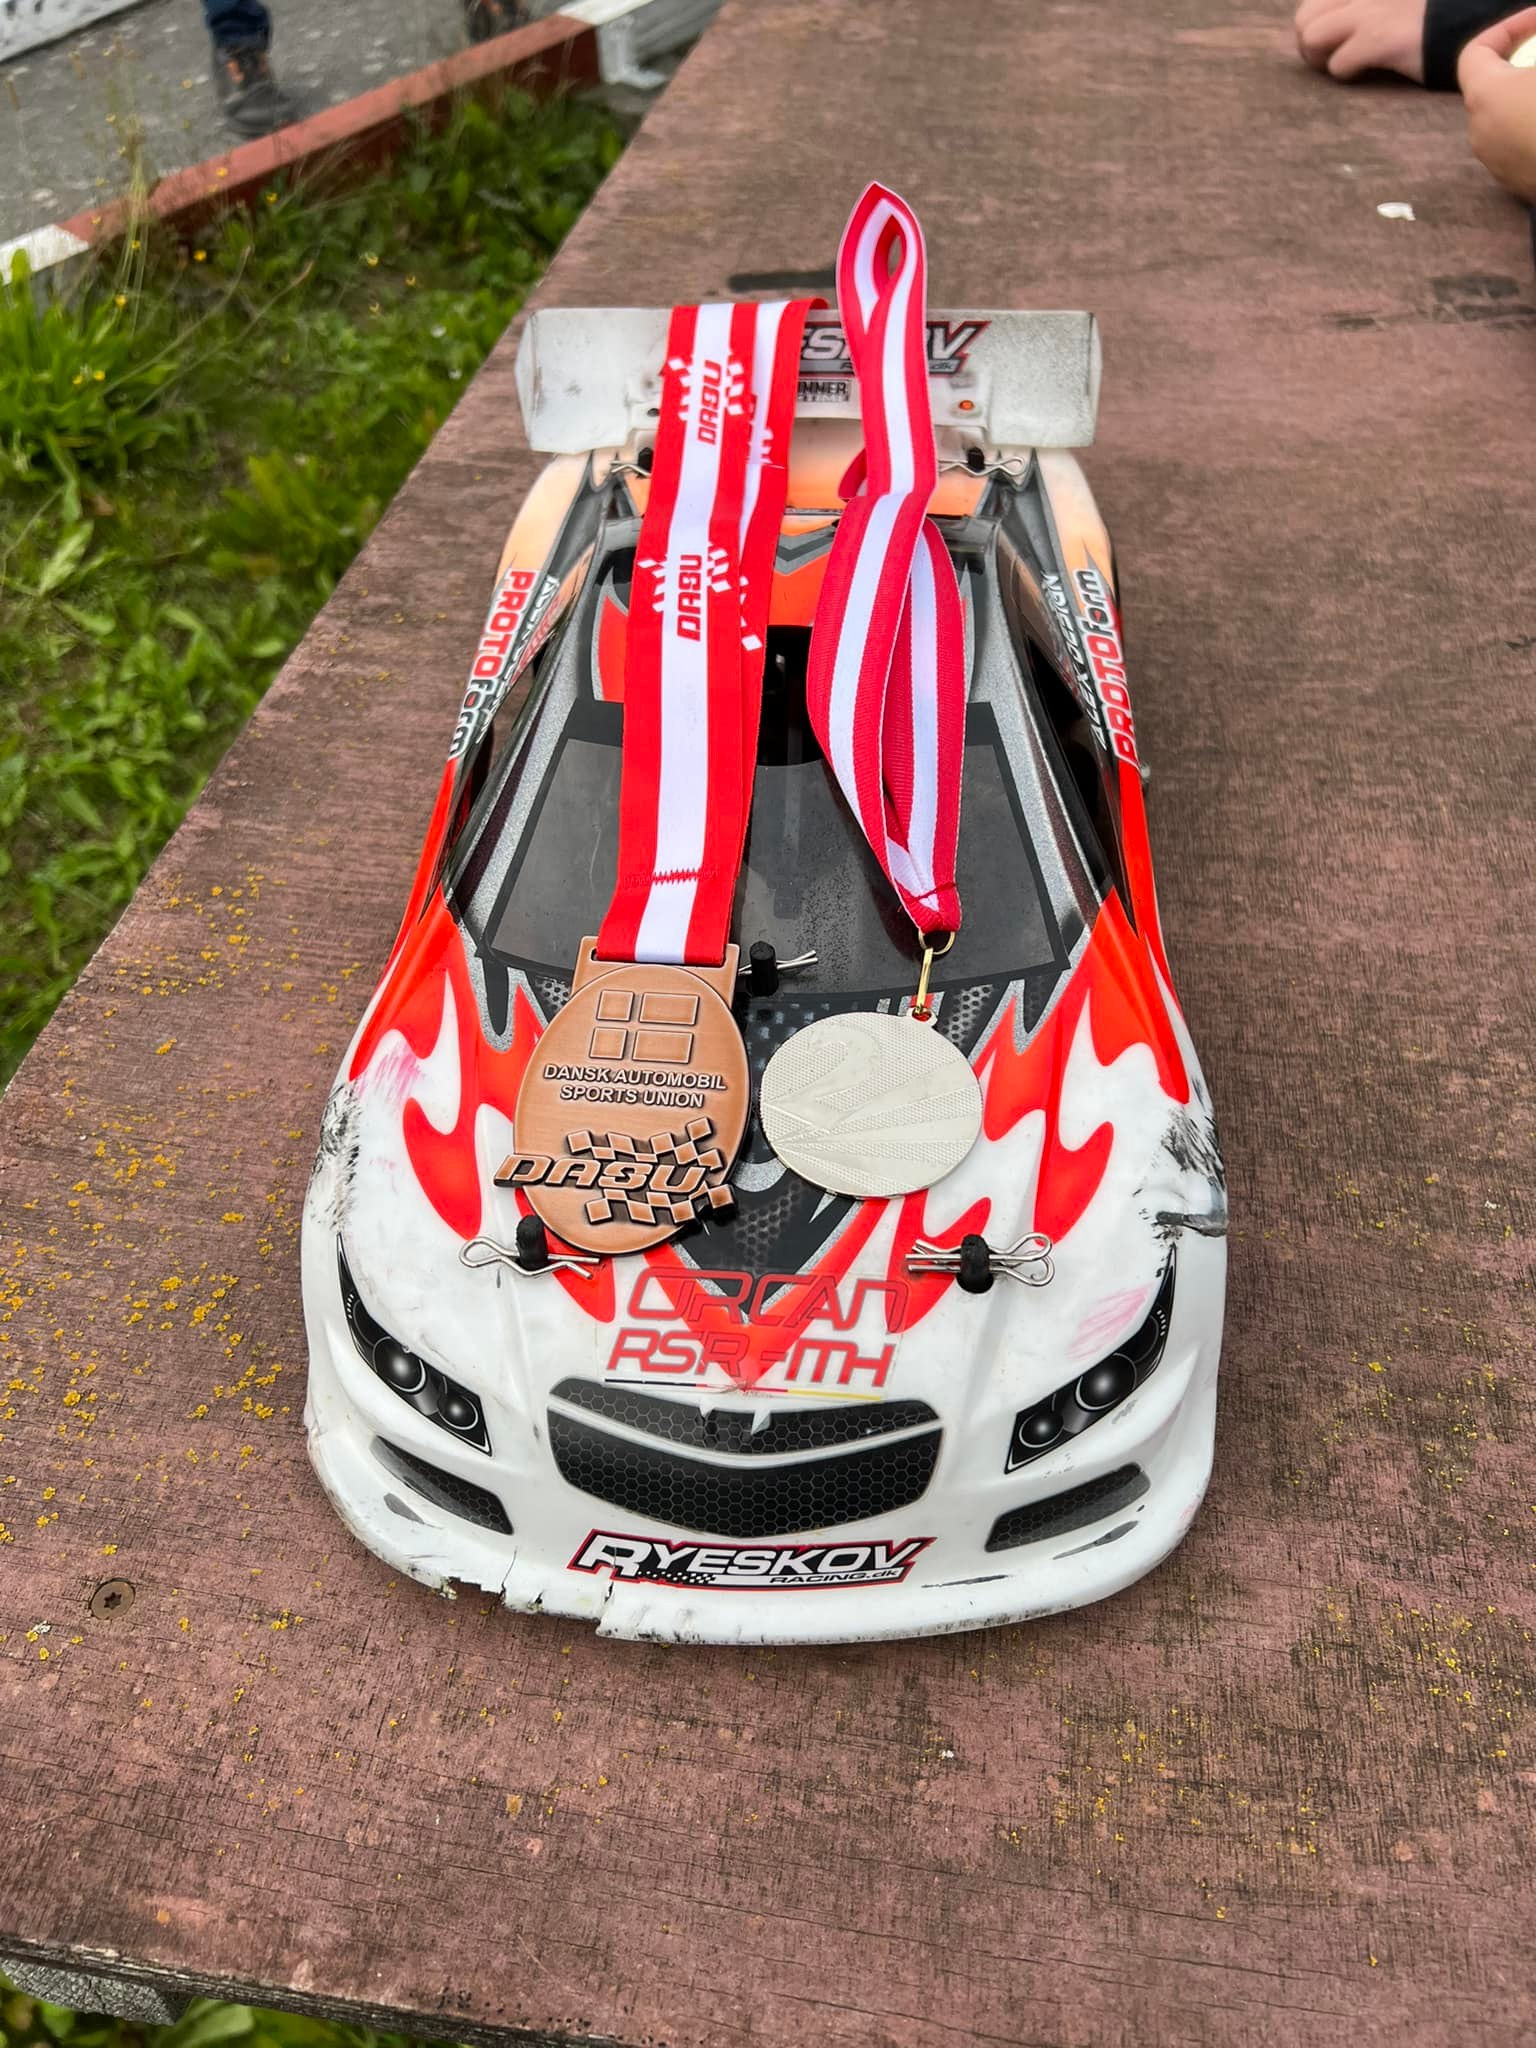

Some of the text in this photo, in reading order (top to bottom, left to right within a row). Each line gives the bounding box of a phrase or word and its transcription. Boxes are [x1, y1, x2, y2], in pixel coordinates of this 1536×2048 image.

[697, 359, 722, 445] DASU
[676, 554, 702, 643] DASU
[544, 1064, 727, 1090] DANSK AUTOMOBIL
[560, 1085, 704, 1108] SPORTS UNION
[493, 1154, 707, 1194] DASU
[627, 1266, 909, 1335] ORCAN
[577, 1534, 921, 1577] RYESKOV
[768, 1569, 898, 1584] RACING.dk
